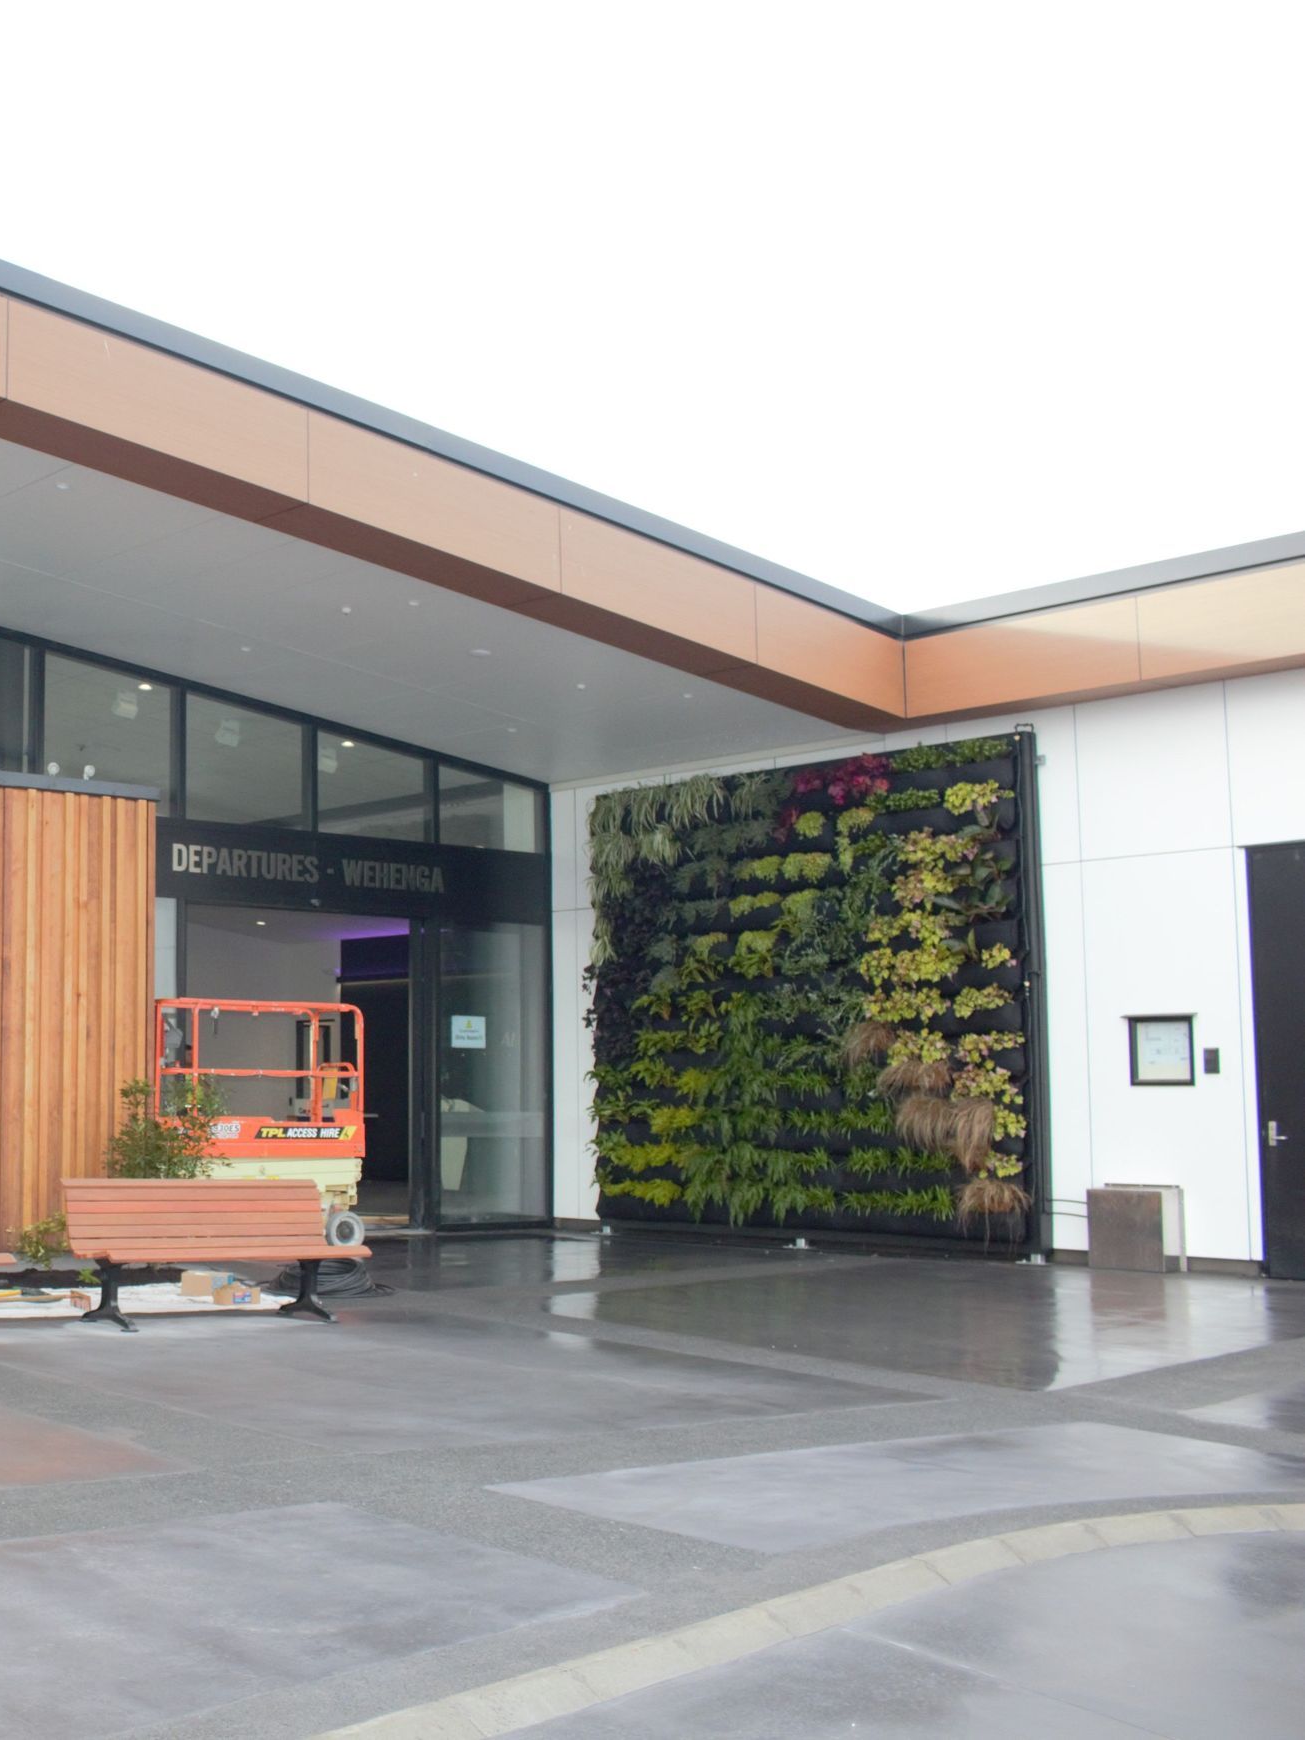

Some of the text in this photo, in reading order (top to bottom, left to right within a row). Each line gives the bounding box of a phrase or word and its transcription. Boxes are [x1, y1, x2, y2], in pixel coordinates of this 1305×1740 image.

[171, 843, 320, 884] DEPARTURES
[341, 858, 445, 894] WEHENGA
[260, 1127, 341, 1138] TPL ACCESS HIRE
